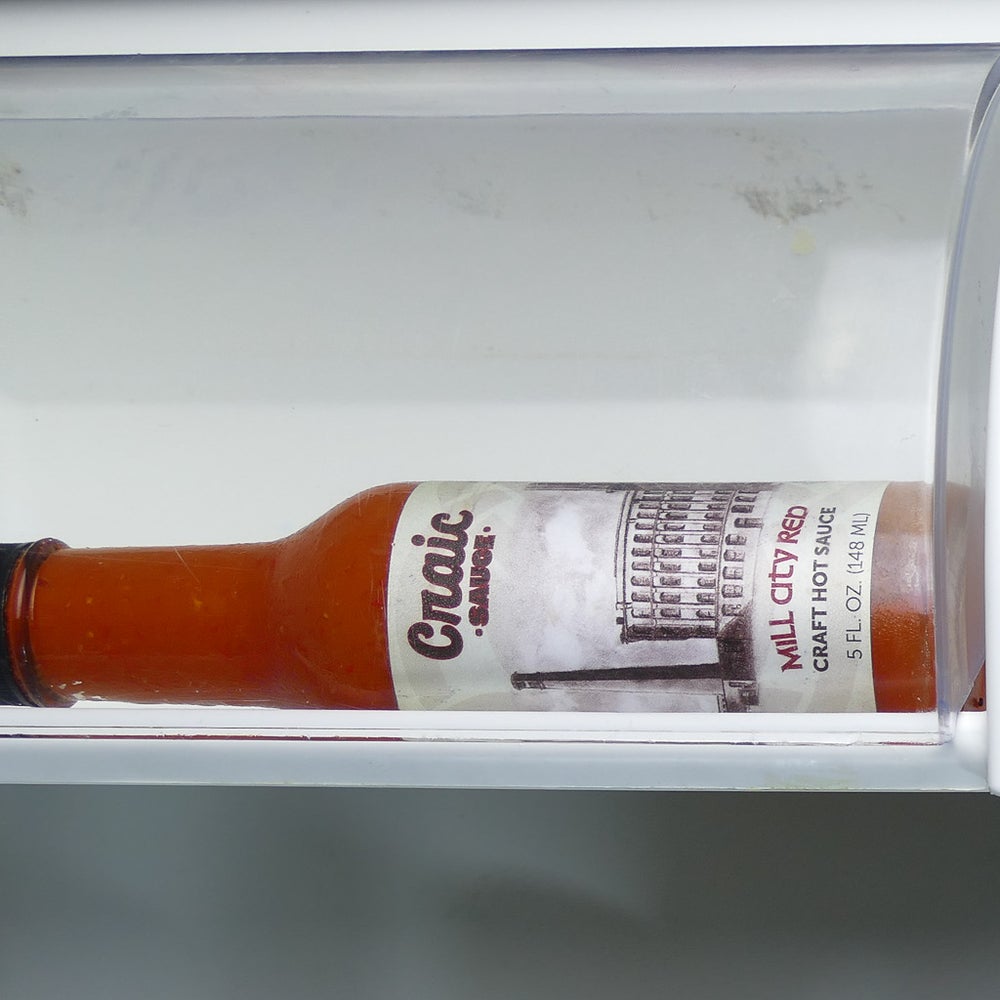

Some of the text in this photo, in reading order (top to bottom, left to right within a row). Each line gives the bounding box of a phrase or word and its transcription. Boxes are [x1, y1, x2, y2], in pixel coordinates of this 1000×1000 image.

[407, 509, 474, 660] Craic
[468, 534, 497, 627] SAUCE
[776, 504, 808, 545] RED
[768, 610, 803, 672] MILL
[811, 506, 836, 672] CRAFT HOT SAUCE
[845, 512, 871, 660] 5 FL. OZ. (148 ML)
